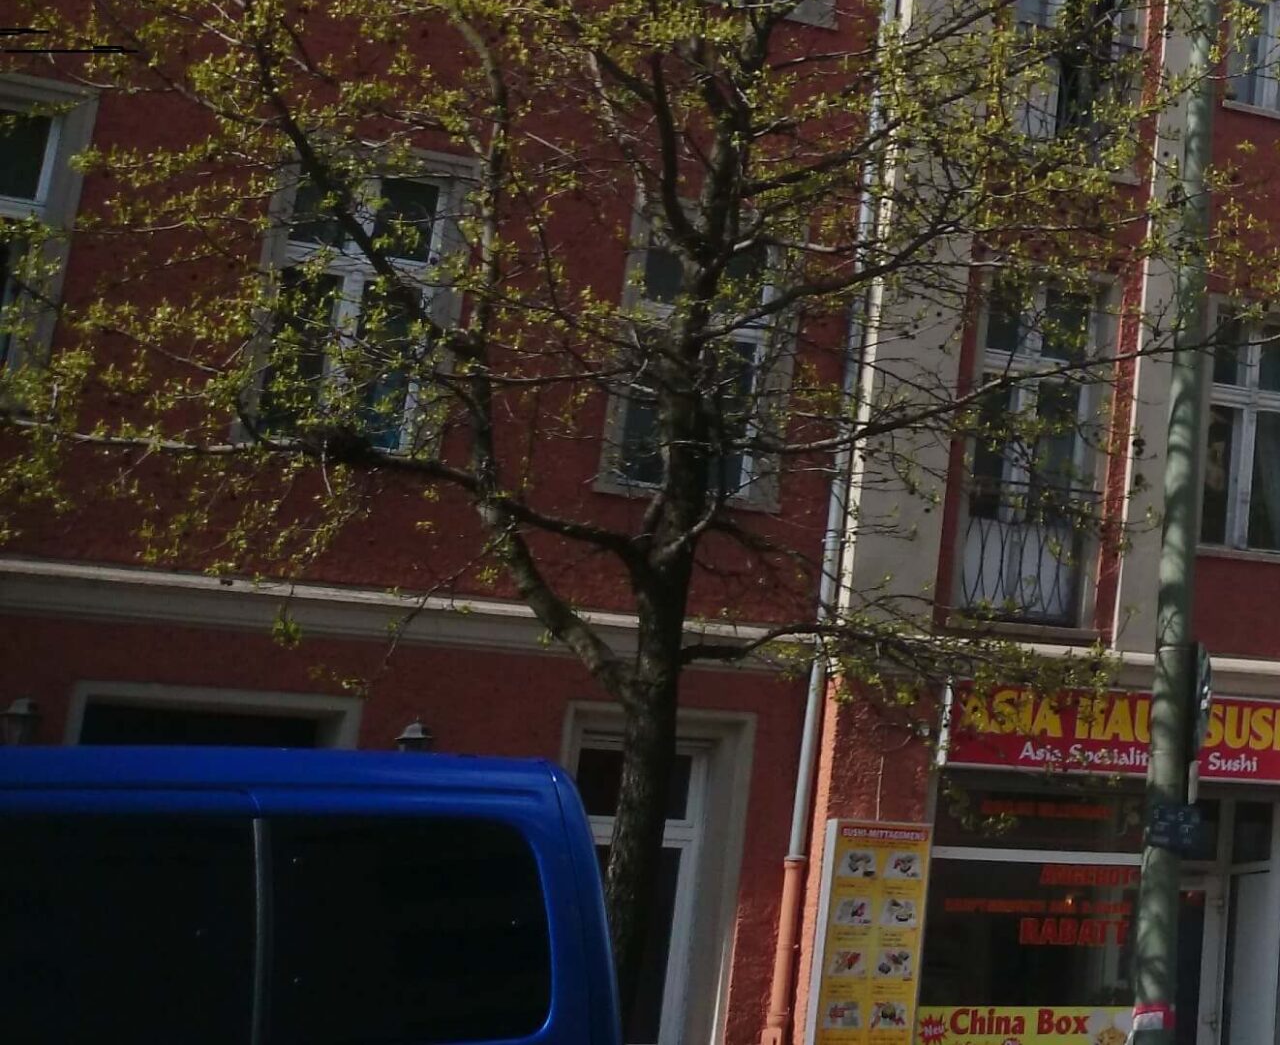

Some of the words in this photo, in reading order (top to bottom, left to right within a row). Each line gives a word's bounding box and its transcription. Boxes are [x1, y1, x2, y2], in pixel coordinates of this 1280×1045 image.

[1074, 694, 1150, 744] HAU
[1207, 751, 1259, 772] Sushi
[1019, 917, 1130, 946] RABATT
[950, 1007, 1026, 1036] China
[1036, 1009, 1090, 1035] Box
